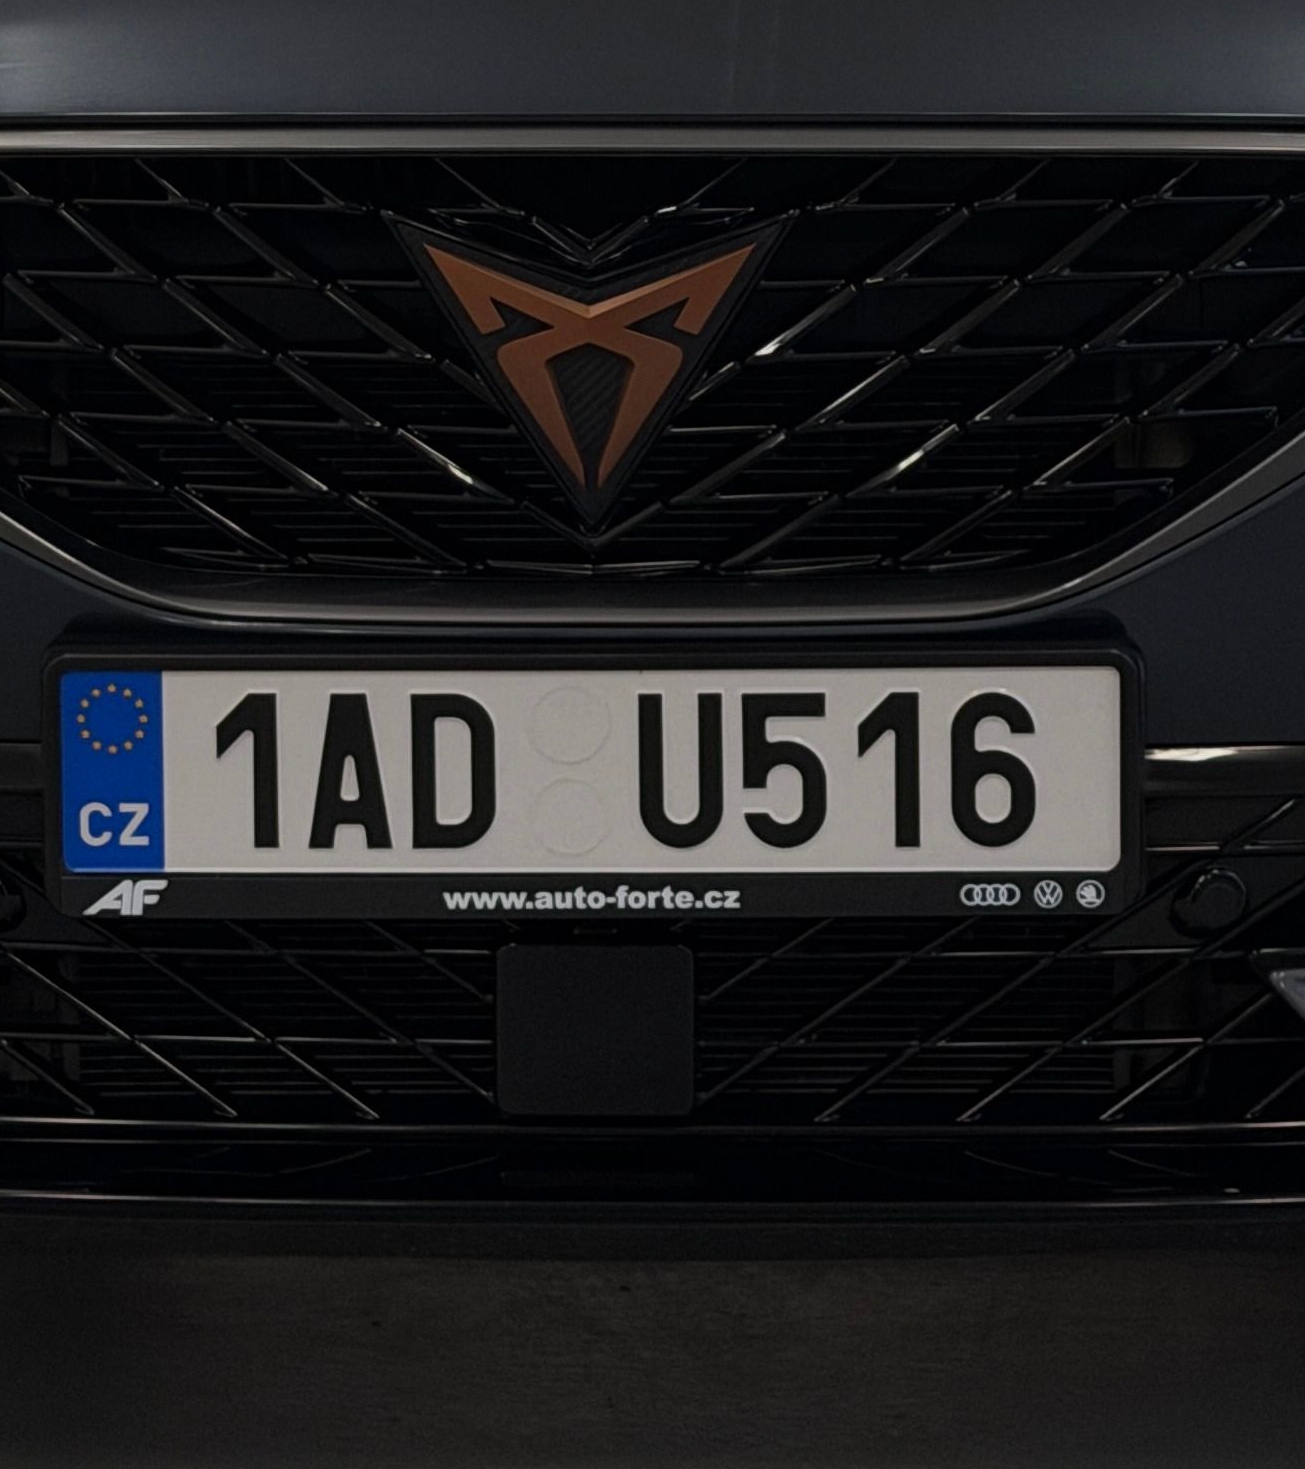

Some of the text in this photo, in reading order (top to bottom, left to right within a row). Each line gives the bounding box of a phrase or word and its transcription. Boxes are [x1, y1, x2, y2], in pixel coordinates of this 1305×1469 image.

[215, 691, 1036, 850] 1AD U516
[79, 802, 150, 847] CZ
[82, 878, 169, 916] AF
[442, 884, 741, 910] www.auto-forte.cz
